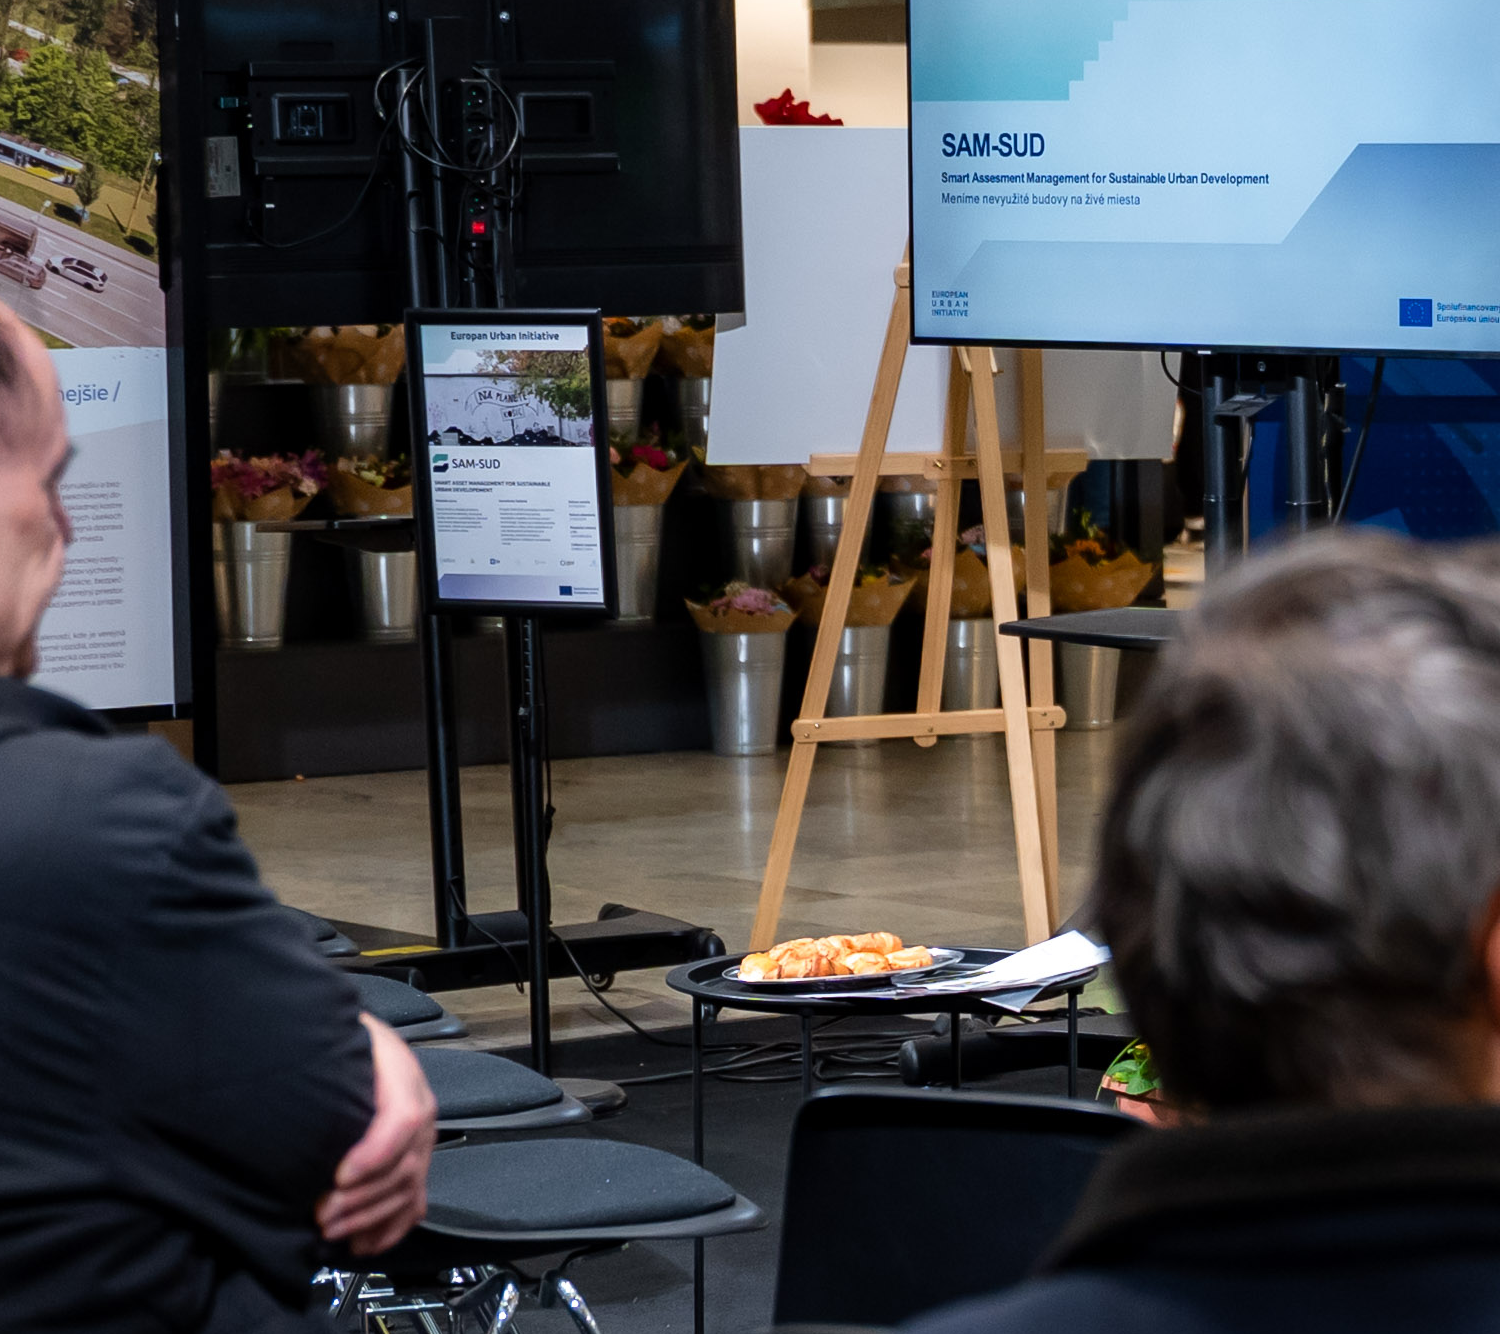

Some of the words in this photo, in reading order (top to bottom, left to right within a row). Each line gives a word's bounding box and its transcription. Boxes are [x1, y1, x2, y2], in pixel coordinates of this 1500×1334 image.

[941, 132, 1045, 158] SAM-SUD
[941, 171, 969, 184] Smart
[972, 171, 1025, 184] Assesment
[1026, 172, 1089, 186] Management
[1092, 172, 1106, 184] for
[1109, 172, 1166, 184] Sustainable
[1168, 172, 1198, 184] Urban
[1201, 173, 1269, 187] Development
[941, 192, 980, 204] Meníme
[982, 192, 1029, 207] nevyužité
[1032, 193, 1068, 207] budovy
[1071, 196, 1083, 205] na
[1085, 193, 1105, 205] živé
[1107, 193, 1140, 205] miesta
[450, 331, 488, 342] Europan
[490, 331, 517, 340] Urban
[518, 331, 560, 341] Initiative
[59, 382, 109, 405] nejšie
[452, 459, 501, 469] SAM-SUD
